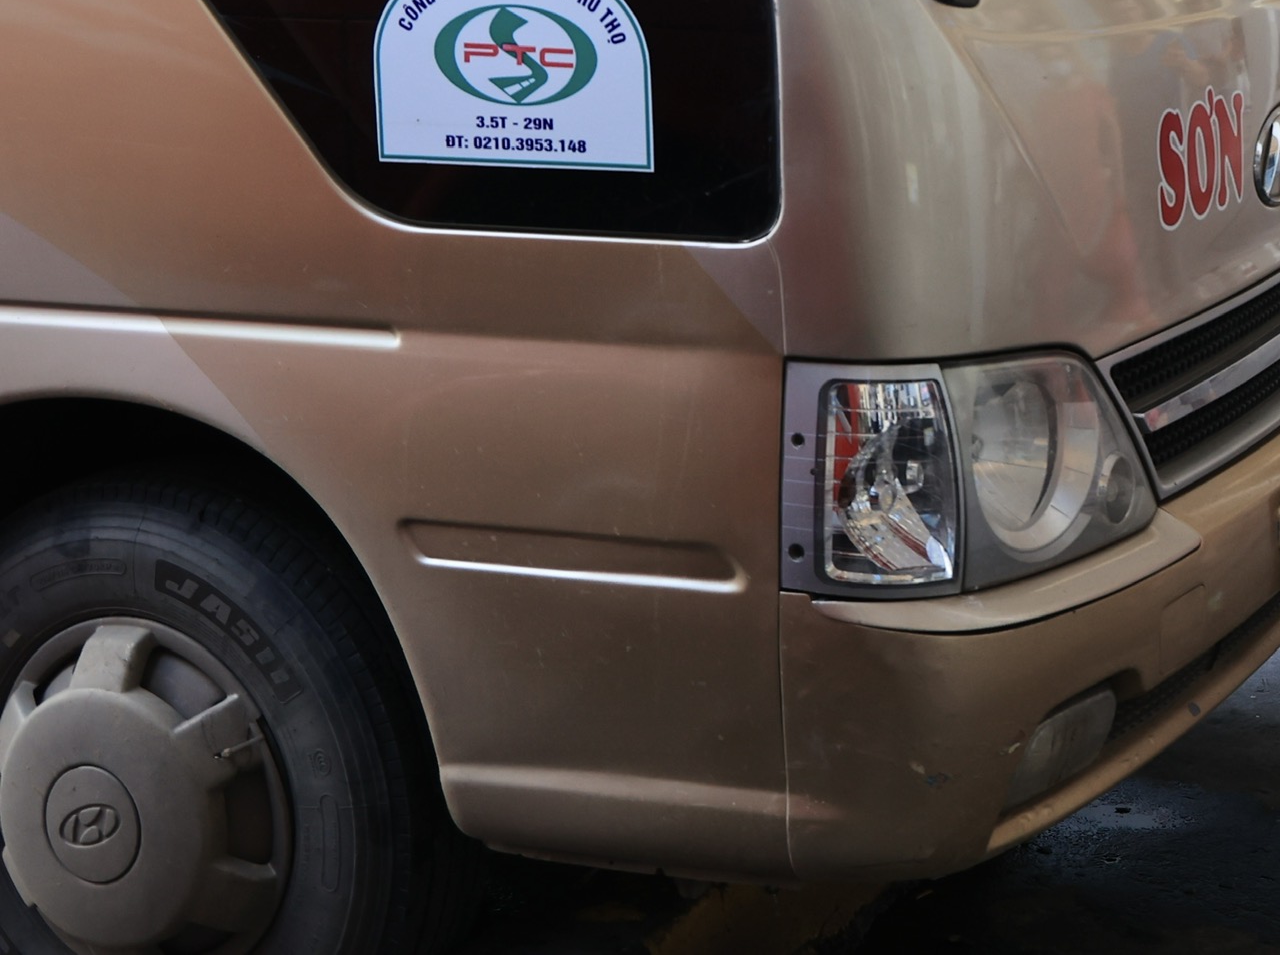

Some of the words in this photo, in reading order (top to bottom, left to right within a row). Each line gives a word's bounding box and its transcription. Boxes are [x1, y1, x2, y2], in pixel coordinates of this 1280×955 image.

[599, 7, 628, 46] THỌ
[463, 41, 575, 69] PTC
[475, 115, 508, 130] 3.5T
[523, 116, 555, 131] 29N
[445, 135, 469, 150] ĐT:
[473, 136, 588, 154] 0210.3953.148
[1158, 85, 1245, 231] SƠN
